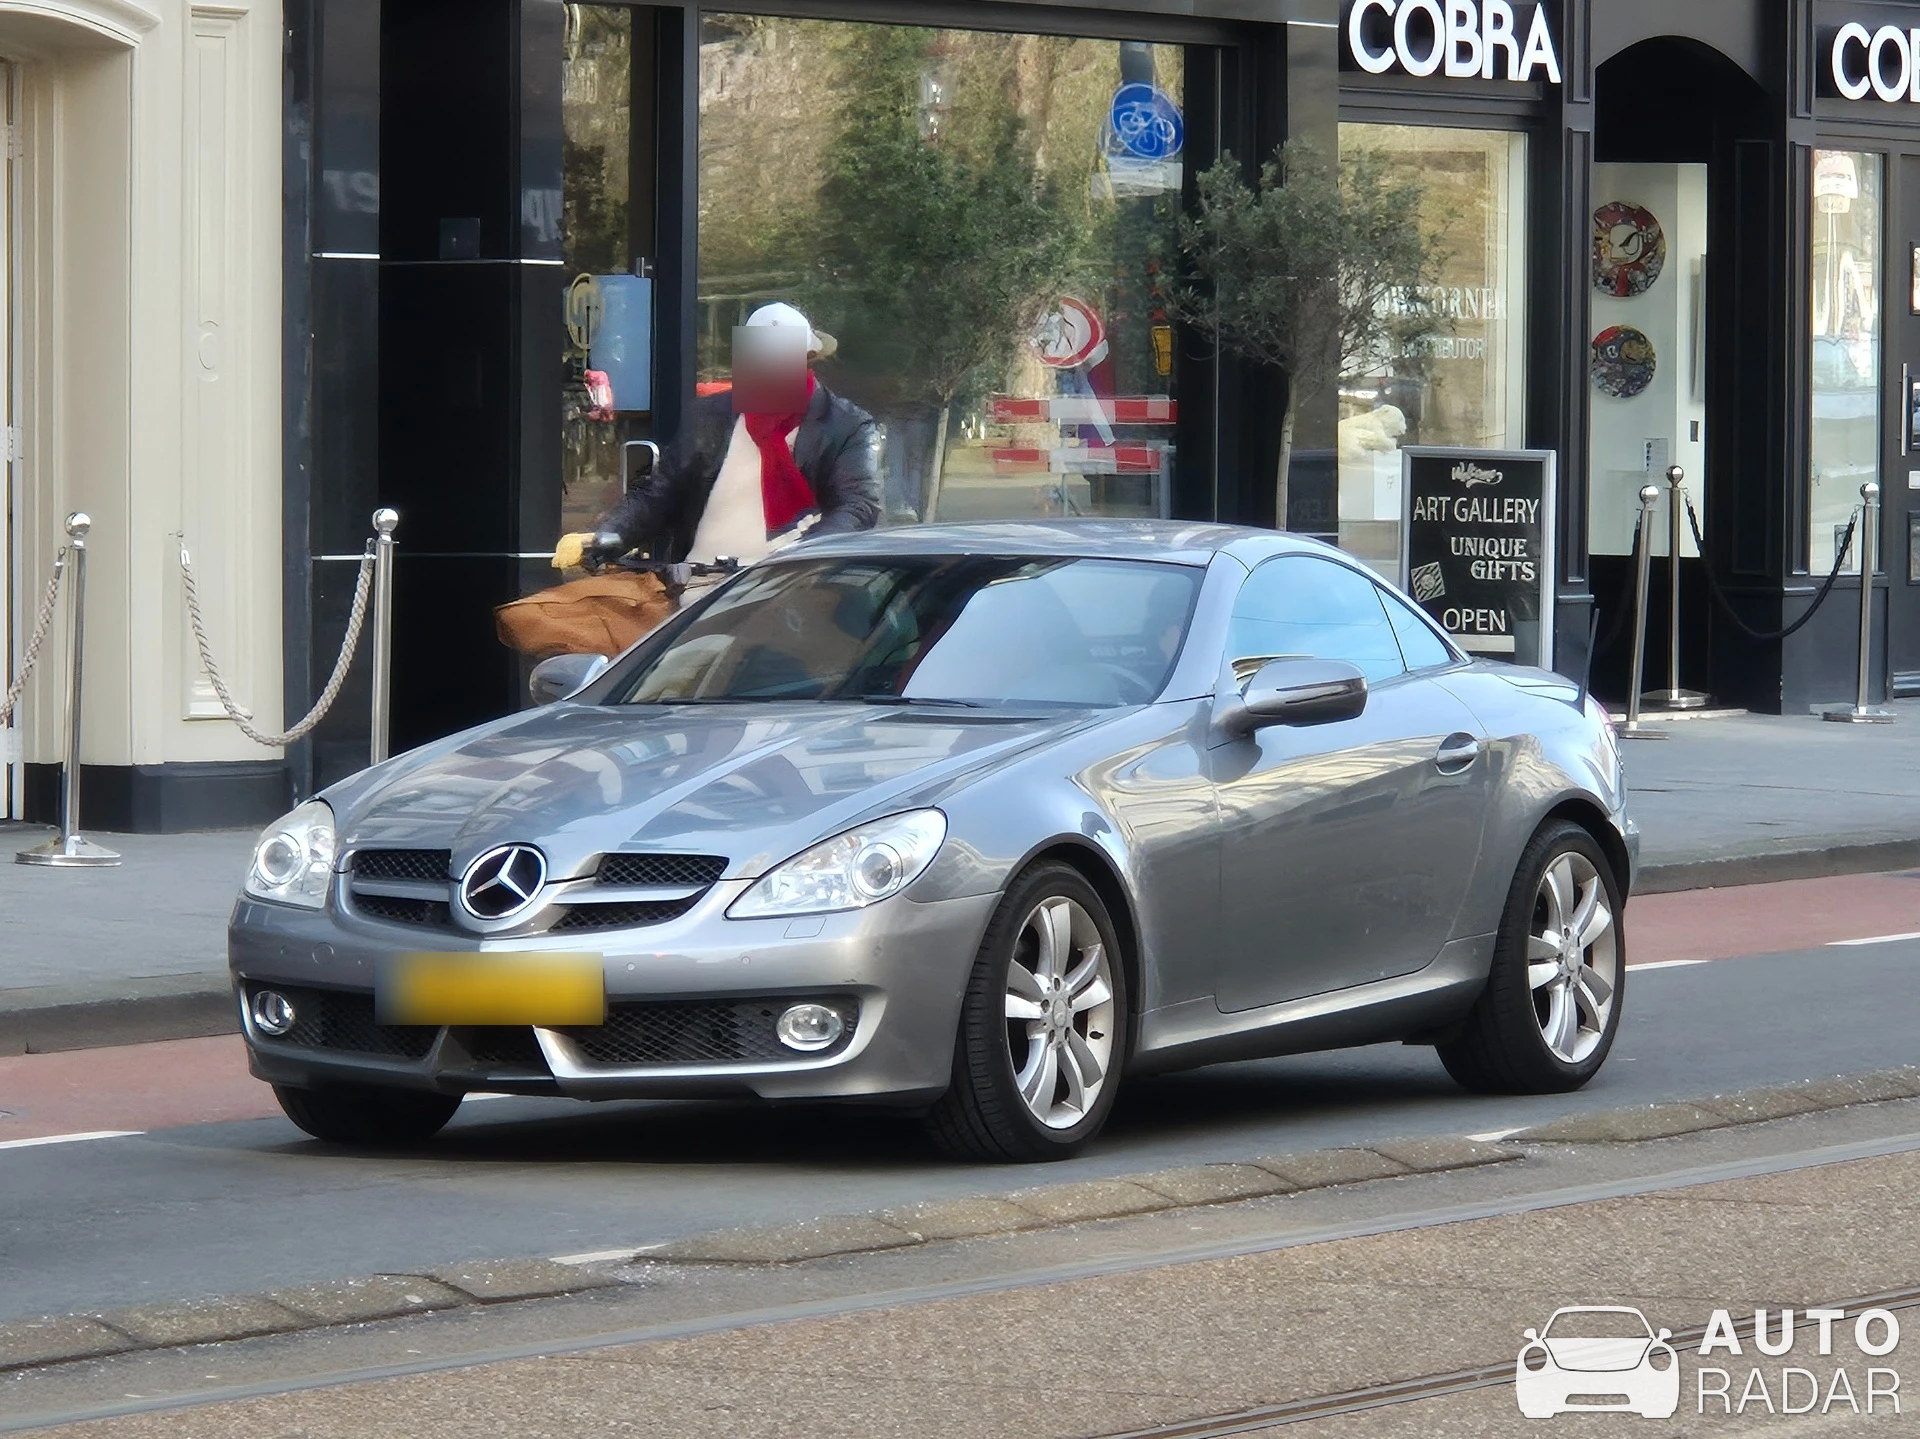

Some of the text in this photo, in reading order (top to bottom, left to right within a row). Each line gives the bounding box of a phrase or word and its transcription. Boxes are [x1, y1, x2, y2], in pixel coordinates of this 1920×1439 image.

[1349, 0, 1562, 83] COBRA
[1413, 496, 1539, 524] ART GALLERY
[1450, 536, 1527, 558] UNIQUE
[1470, 560, 1535, 581] GIFTS
[1443, 608, 1506, 632] OPEN
